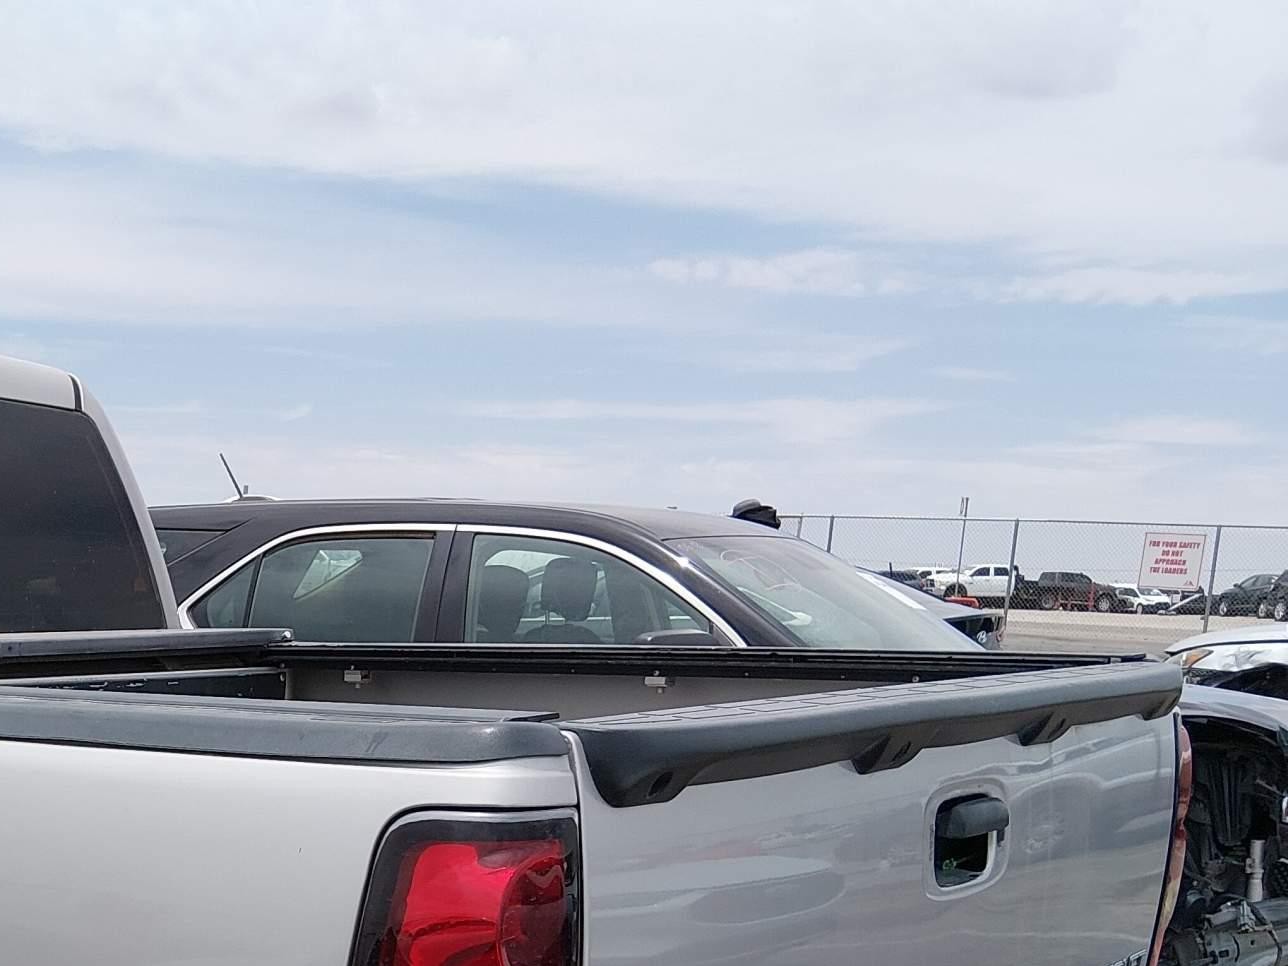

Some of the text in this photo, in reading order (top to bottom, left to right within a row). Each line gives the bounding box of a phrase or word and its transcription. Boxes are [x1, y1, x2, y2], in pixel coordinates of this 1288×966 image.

[1178, 541, 1201, 549] SAFETY
[1161, 549, 1171, 557] DO
[1154, 558, 1187, 566] APPROACH
[1149, 566, 1188, 575] THE LOADERS
